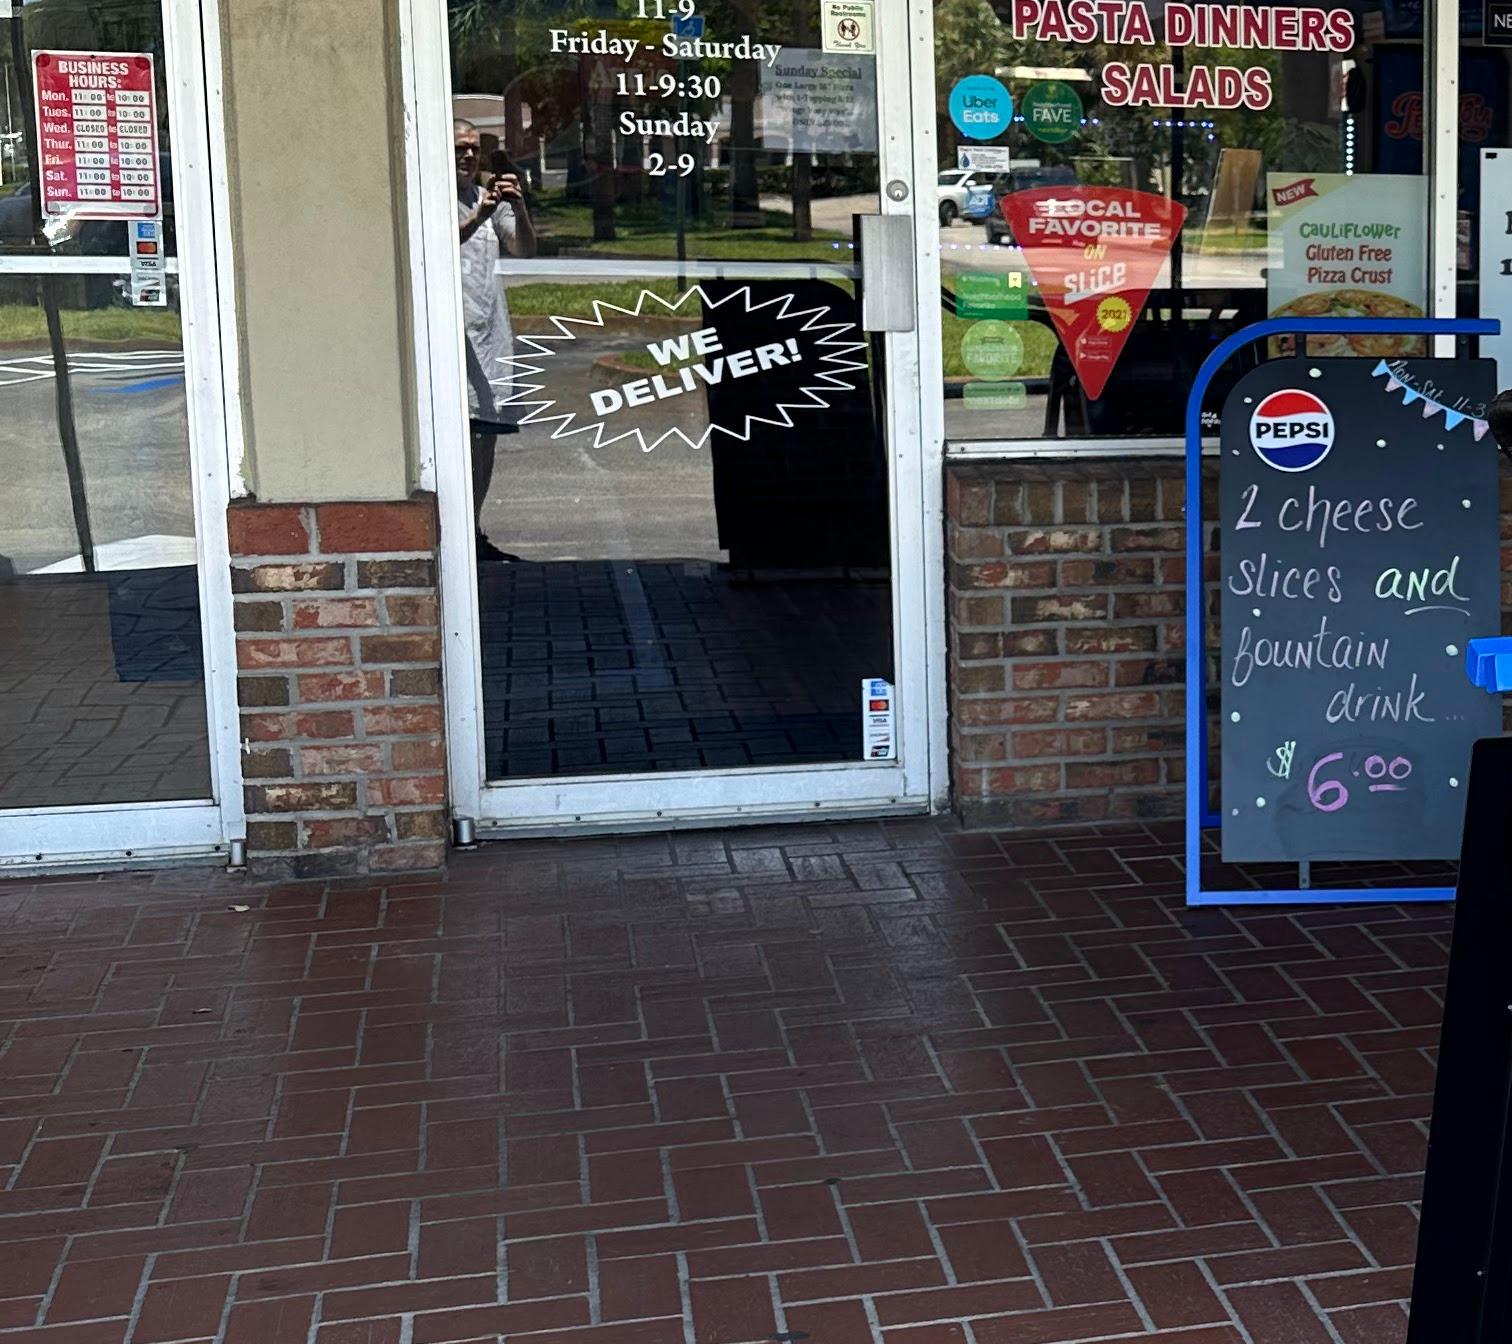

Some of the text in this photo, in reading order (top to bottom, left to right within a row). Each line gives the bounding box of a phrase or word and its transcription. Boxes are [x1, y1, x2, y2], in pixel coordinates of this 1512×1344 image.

[1164, 2, 1354, 52] DINNERS
[549, 29, 639, 63] Friday
[662, 31, 782, 67] Saturday
[58, 60, 129, 75] BUSINESS
[69, 75, 122, 89] HOURS:
[616, 71, 721, 99] 11-9:30
[1101, 63, 1273, 110] SALADS
[42, 90, 70, 101] Mon.
[962, 95, 999, 109] Uber
[42, 106, 71, 117] Tues.
[963, 109, 1000, 124] Eats
[1032, 108, 1073, 123] FAVE
[43, 122, 71, 133] Wed.
[619, 111, 720, 144] Sunday
[44, 138, 72, 149] Thur.
[45, 154, 64, 165] Fri.
[648, 153, 695, 177] 2-9
[46, 170, 68, 181] Sat.
[47, 186, 72, 197] Sun.
[1276, 185, 1306, 203] NEW
[1028, 218, 1161, 240] FAVORITE
[1306, 244, 1393, 262] Gluten Free
[1307, 267, 1393, 284] Pizza Crust
[646, 327, 724, 366] WE
[590, 338, 803, 416] DELIVER!
[1255, 420, 1330, 440] PEPSI
[1234, 484, 1424, 548] 2 cheese
